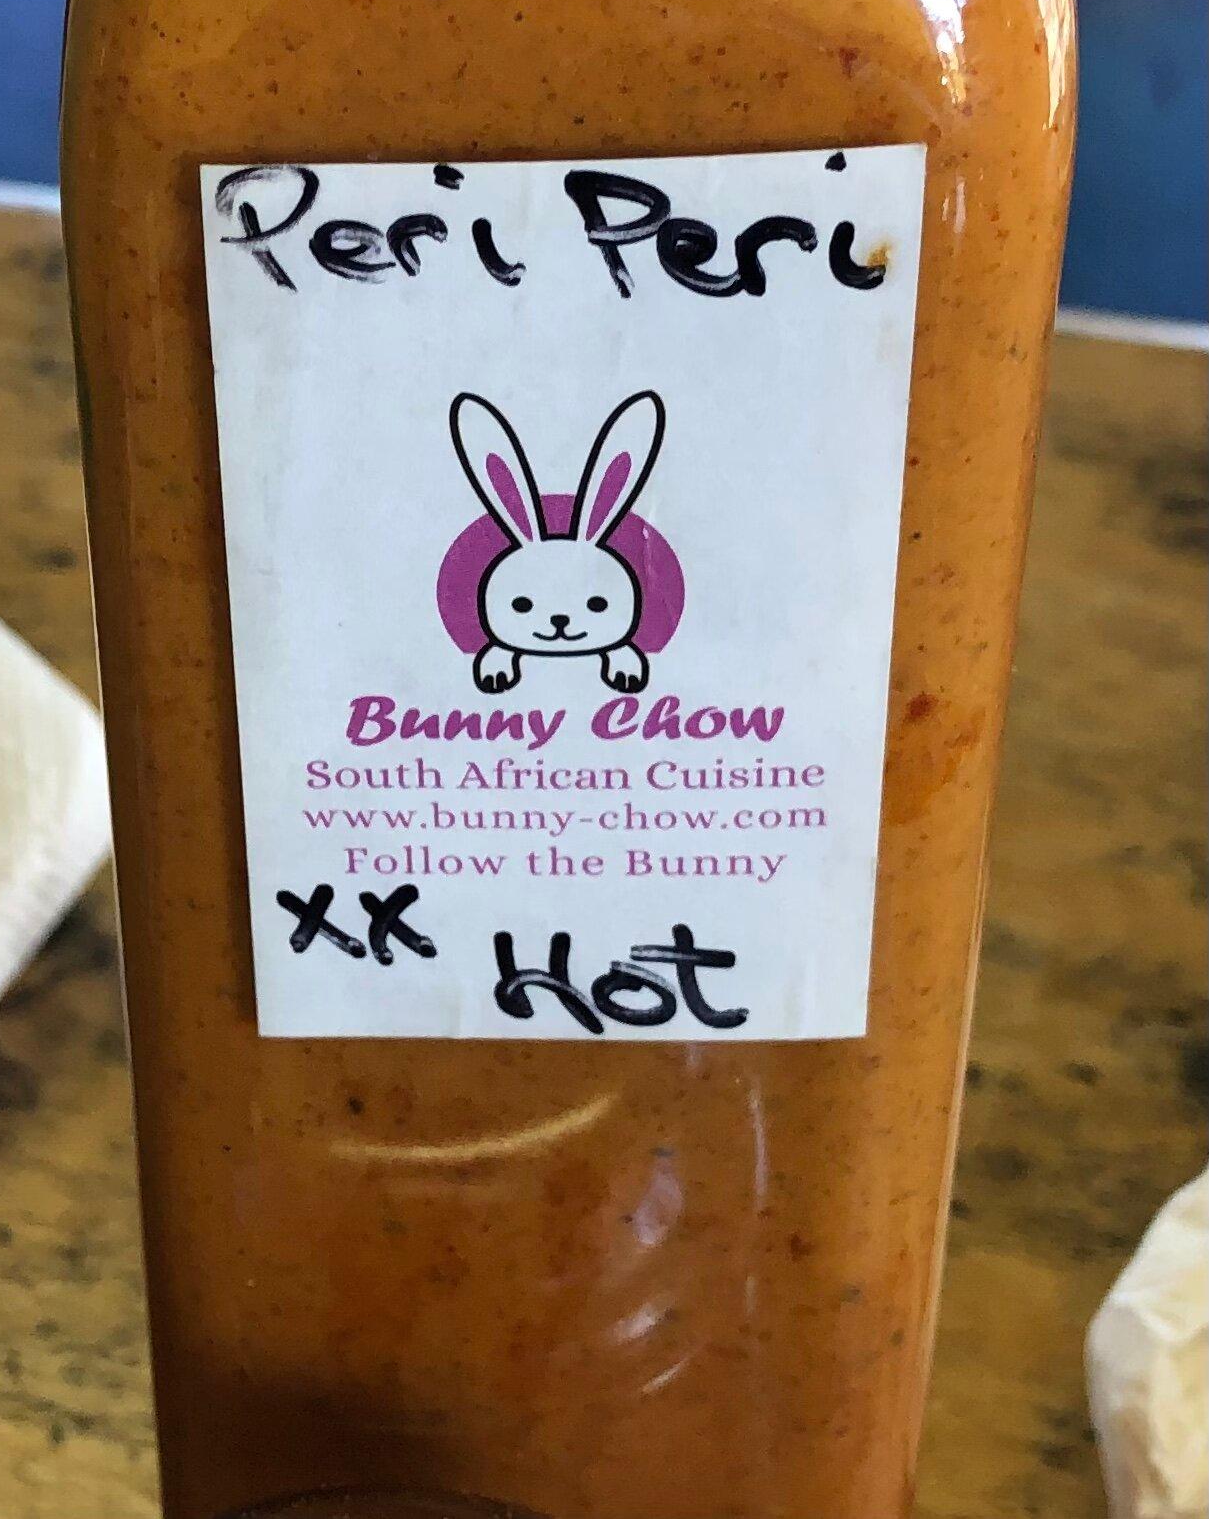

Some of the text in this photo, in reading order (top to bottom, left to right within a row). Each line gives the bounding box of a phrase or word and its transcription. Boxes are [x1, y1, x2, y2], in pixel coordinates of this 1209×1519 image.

[215, 150, 888, 299] Peri Peri
[345, 694, 784, 750] Bunny Chow
[305, 759, 825, 791] South African Cuisine
[303, 802, 828, 836] www.bunny-chow.com
[343, 846, 789, 882] Follow the Bunny
[492, 923, 749, 1034] Hot
